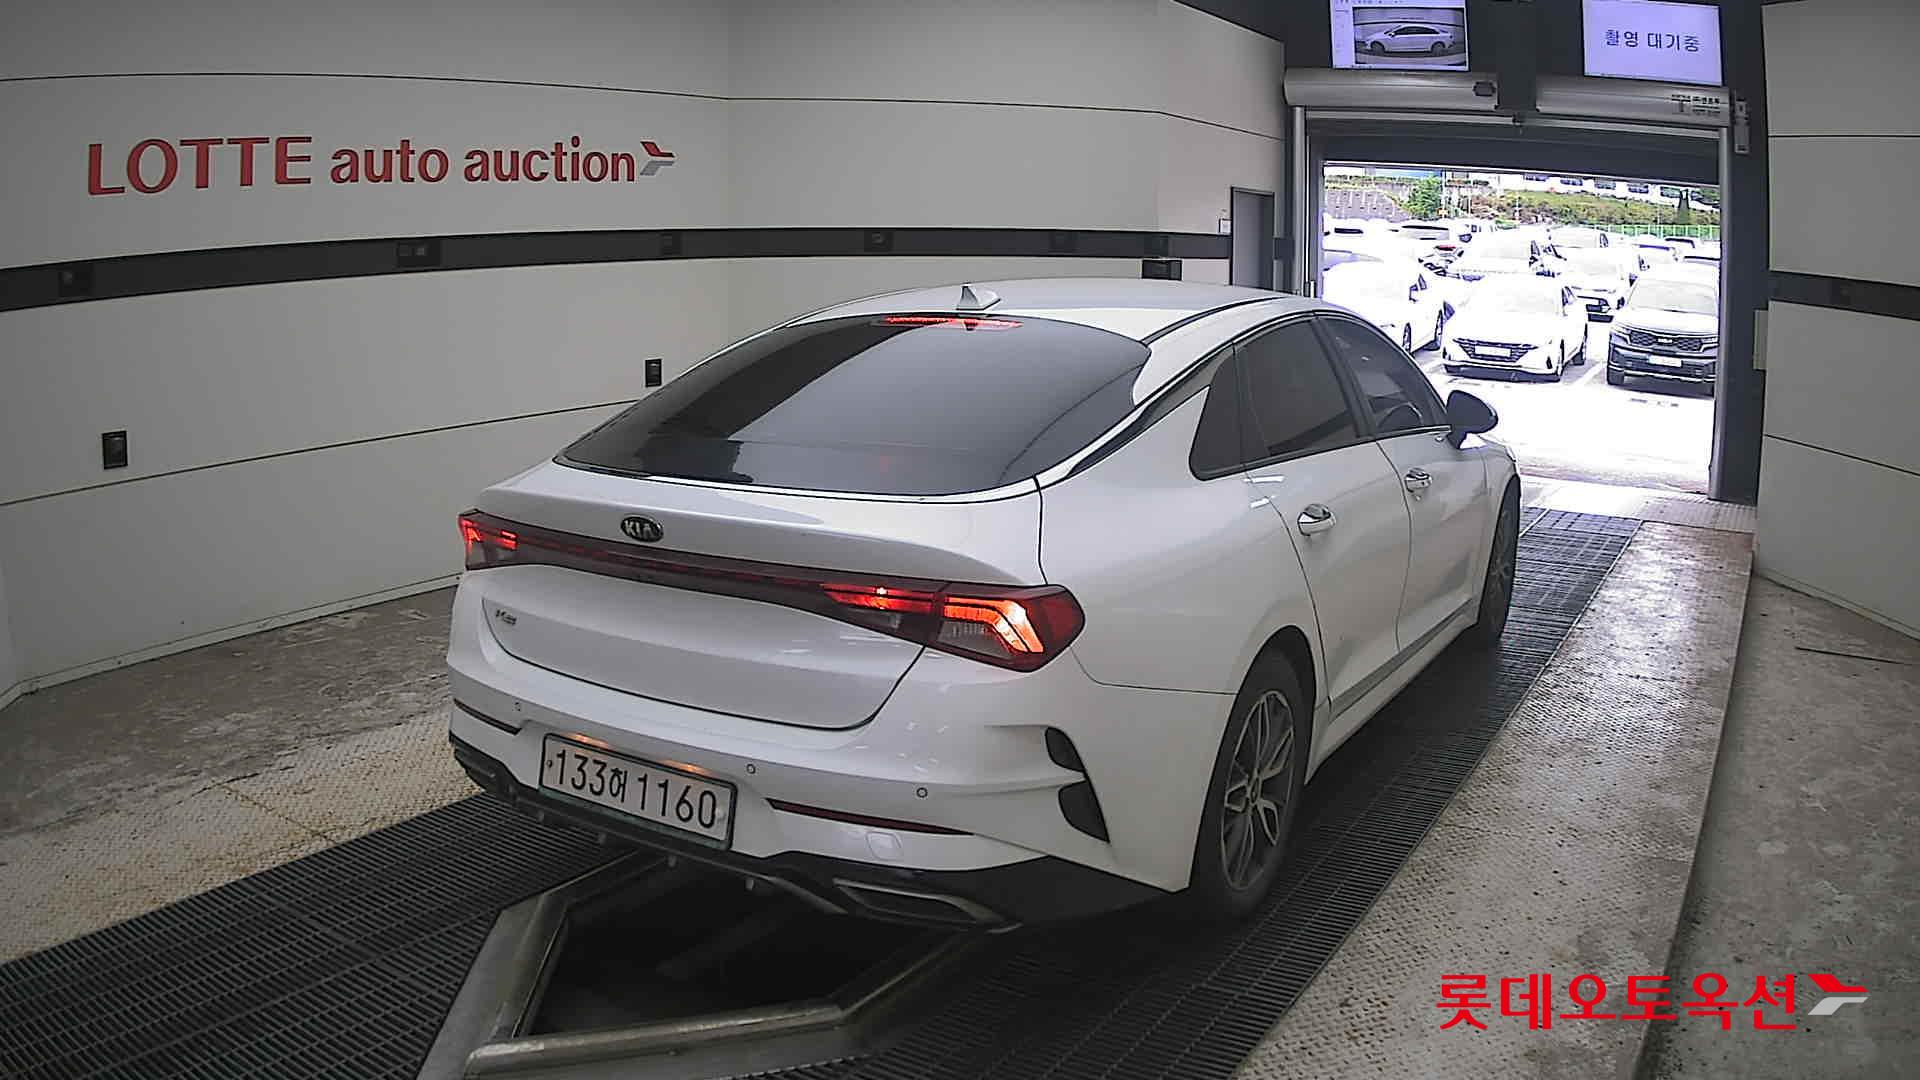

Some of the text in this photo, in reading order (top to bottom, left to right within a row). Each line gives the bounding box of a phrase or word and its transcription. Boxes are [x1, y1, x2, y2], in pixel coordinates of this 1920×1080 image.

[1647, 32, 1700, 52] 대기중
[88, 136, 636, 195] LOTTE auto auction
[623, 519, 655, 539] KIA
[637, 773, 717, 829] 1160
